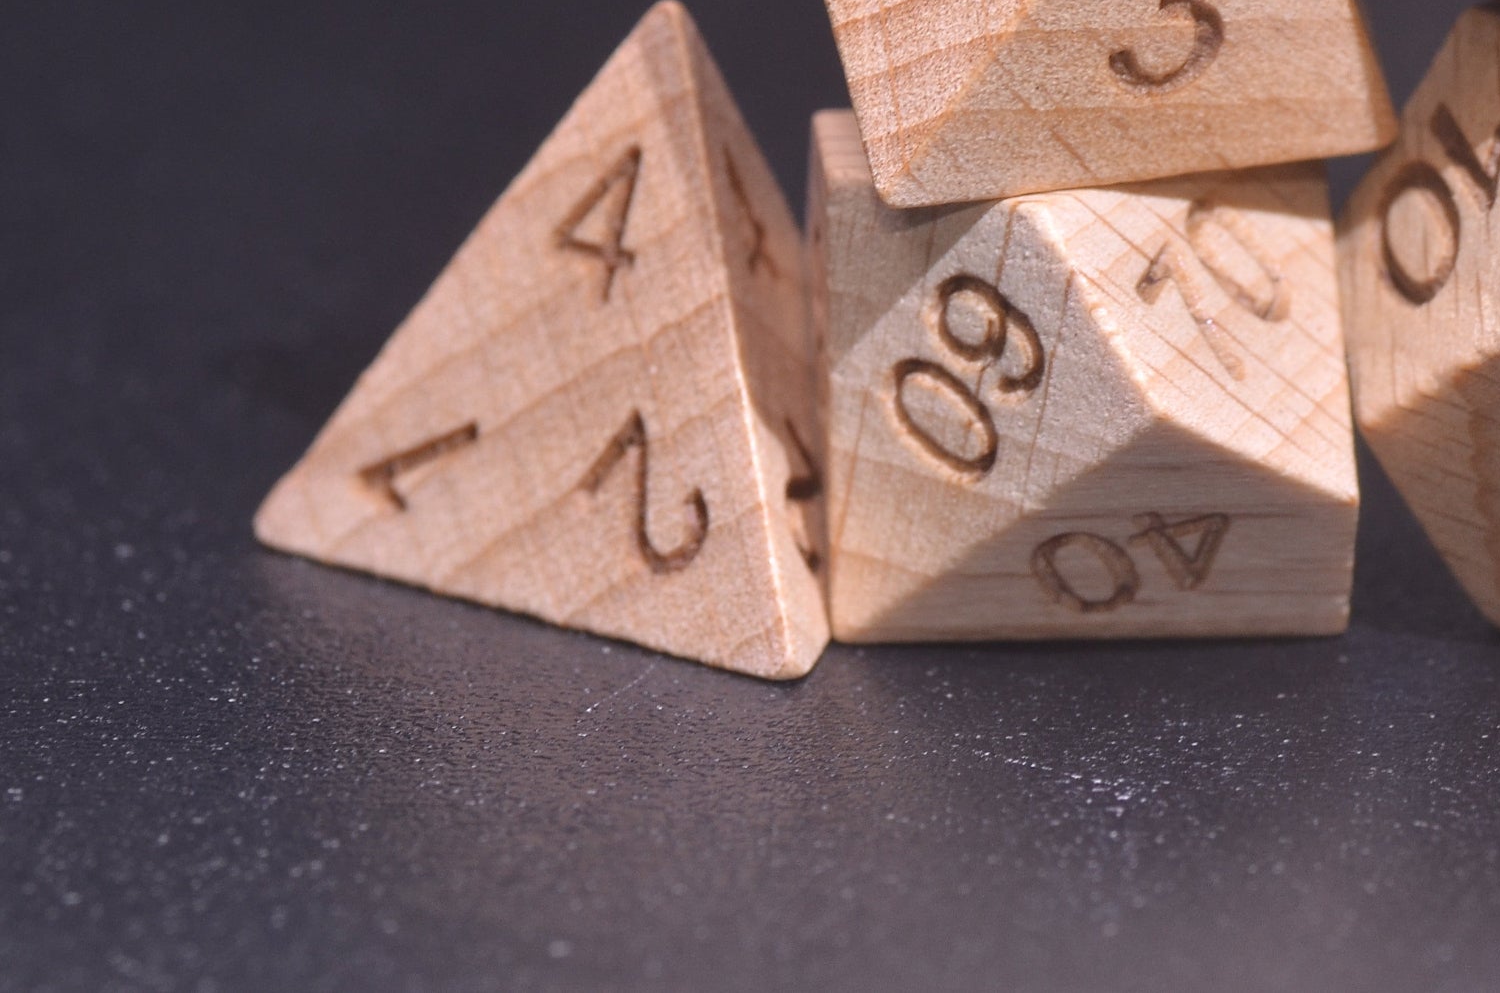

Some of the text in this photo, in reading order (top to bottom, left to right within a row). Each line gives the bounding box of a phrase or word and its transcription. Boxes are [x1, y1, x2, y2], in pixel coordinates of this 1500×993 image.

[554, 145, 643, 303] 4
[887, 272, 1045, 482] 60
[357, 420, 480, 513] 1
[578, 407, 710, 575] 2
[1030, 511, 1232, 614] 40
